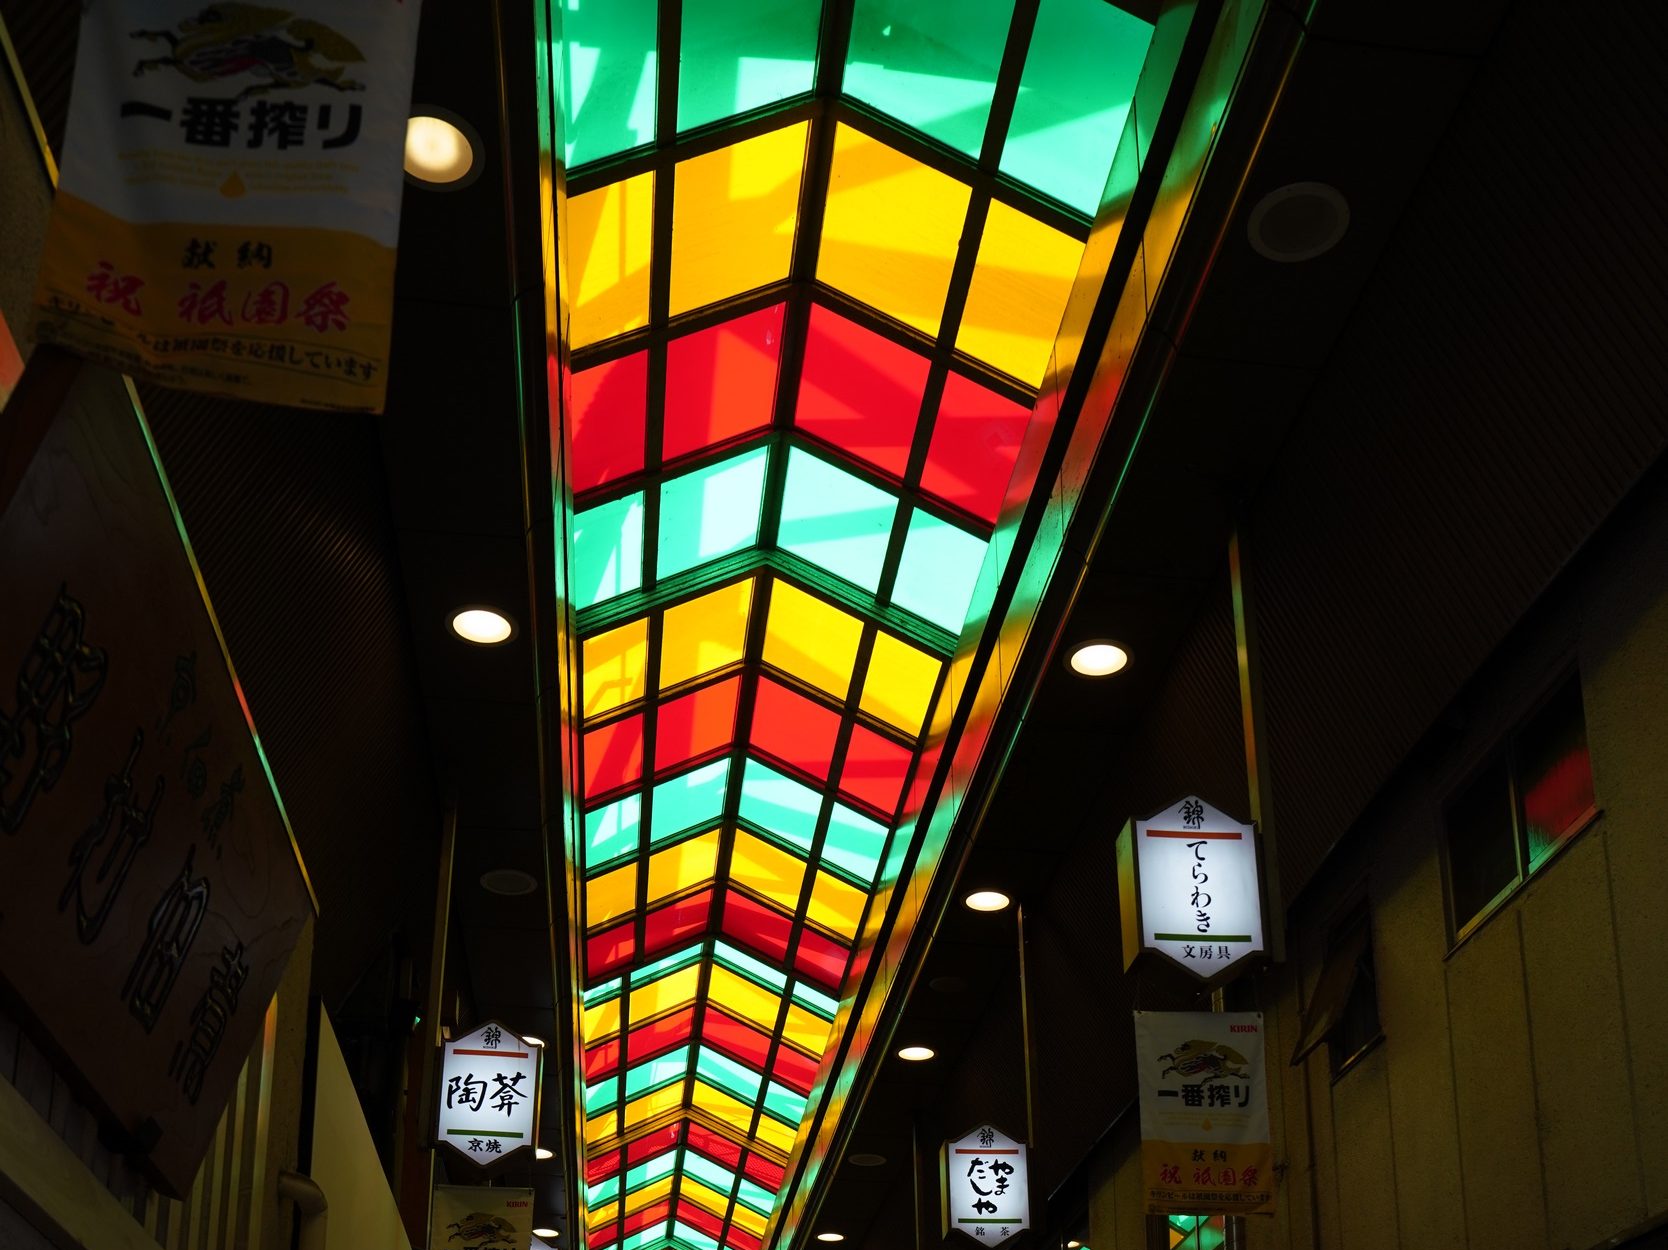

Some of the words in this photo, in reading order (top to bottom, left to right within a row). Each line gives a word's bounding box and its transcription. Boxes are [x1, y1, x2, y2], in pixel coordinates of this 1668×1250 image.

[121, 97, 362, 149] 一番搾り
[182, 238, 273, 269] 献納
[85, 261, 145, 316] 祝
[177, 280, 350, 333] 祇園祭
[1178, 800, 1204, 830] 錦
[1187, 840, 1212, 933] てらわき
[1182, 944, 1231, 960] 文房具
[481, 1026, 502, 1049] 錦
[1230, 1025, 1258, 1033] KIRIN
[1158, 1084, 1249, 1107] 一番搾り
[468, 1138, 502, 1154] 京焼
[977, 1128, 994, 1148] 錦
[967, 1157, 997, 1215] だしや
[989, 1159, 1014, 1196] やま
